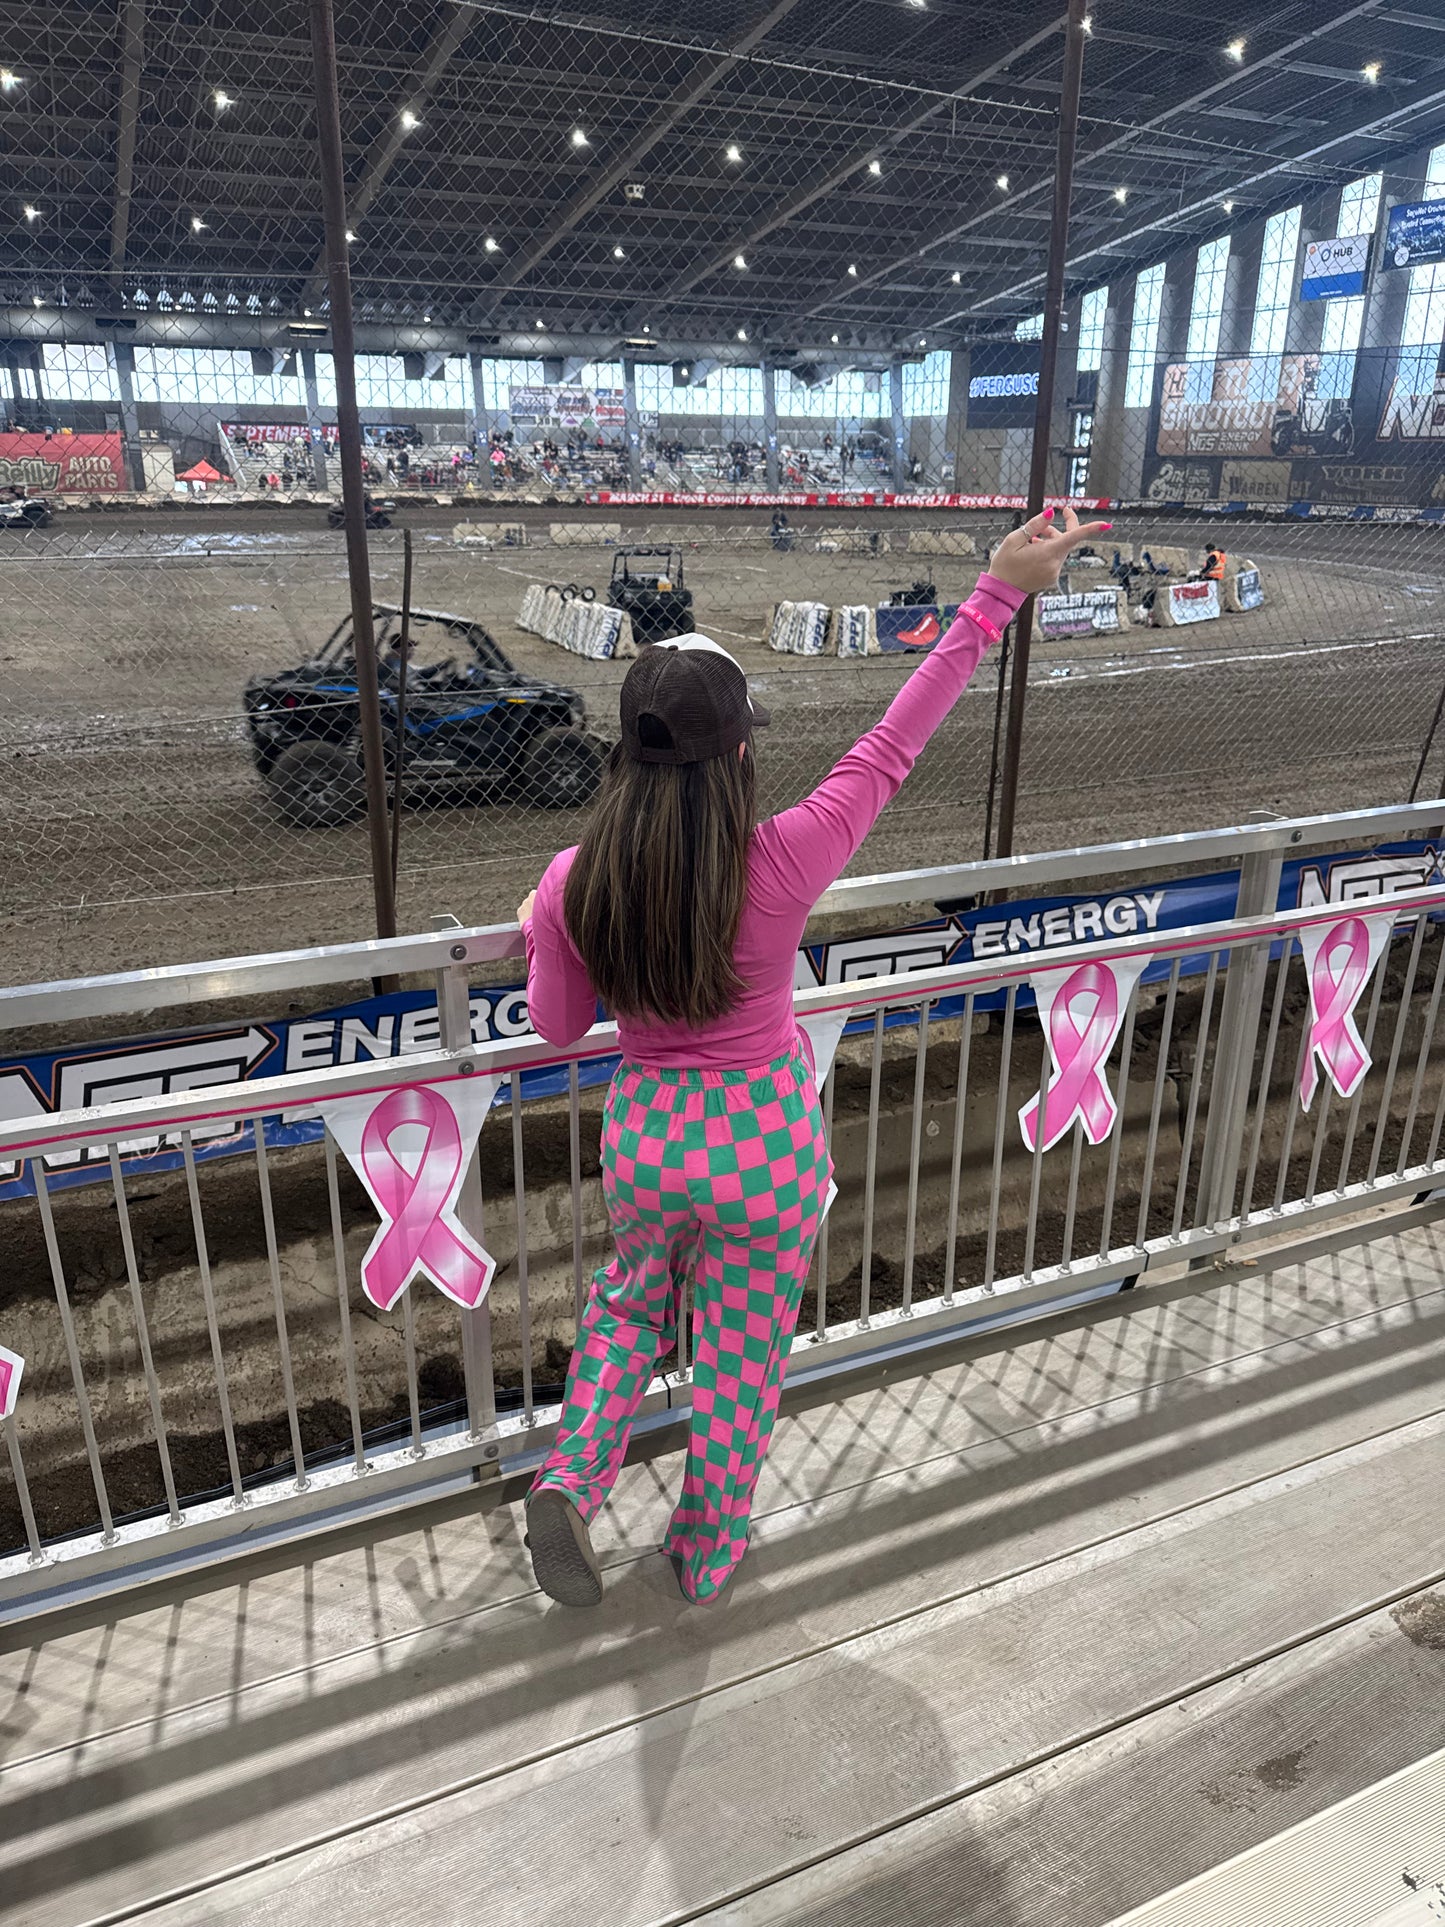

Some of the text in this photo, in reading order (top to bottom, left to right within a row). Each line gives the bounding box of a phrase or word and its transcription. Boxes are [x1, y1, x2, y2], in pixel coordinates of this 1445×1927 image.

[1333, 247, 1354, 259] HUB
[1161, 399, 1285, 431] SHOOTOUT
[1220, 431, 1261, 442] ENERGY
[1217, 442, 1250, 452] DRINK
[69, 456, 113, 472] AUTO
[65, 472, 119, 489] PARTS
[1321, 466, 1407, 482] YORK
[1230, 476, 1280, 496] WARREN
[608, 493, 650, 504] MARCH
[673, 493, 706, 505] Creek
[707, 494, 746, 506] County
[748, 494, 808, 506] Speedway
[957, 495, 991, 507] Creek
[993, 496, 1028, 508] Count
[1043, 498, 1100, 510] peedway
[1041, 591, 1117, 612] TRAILER PARTS
[972, 890, 1166, 959] ENERGY
[286, 990, 532, 1072] ENERG
